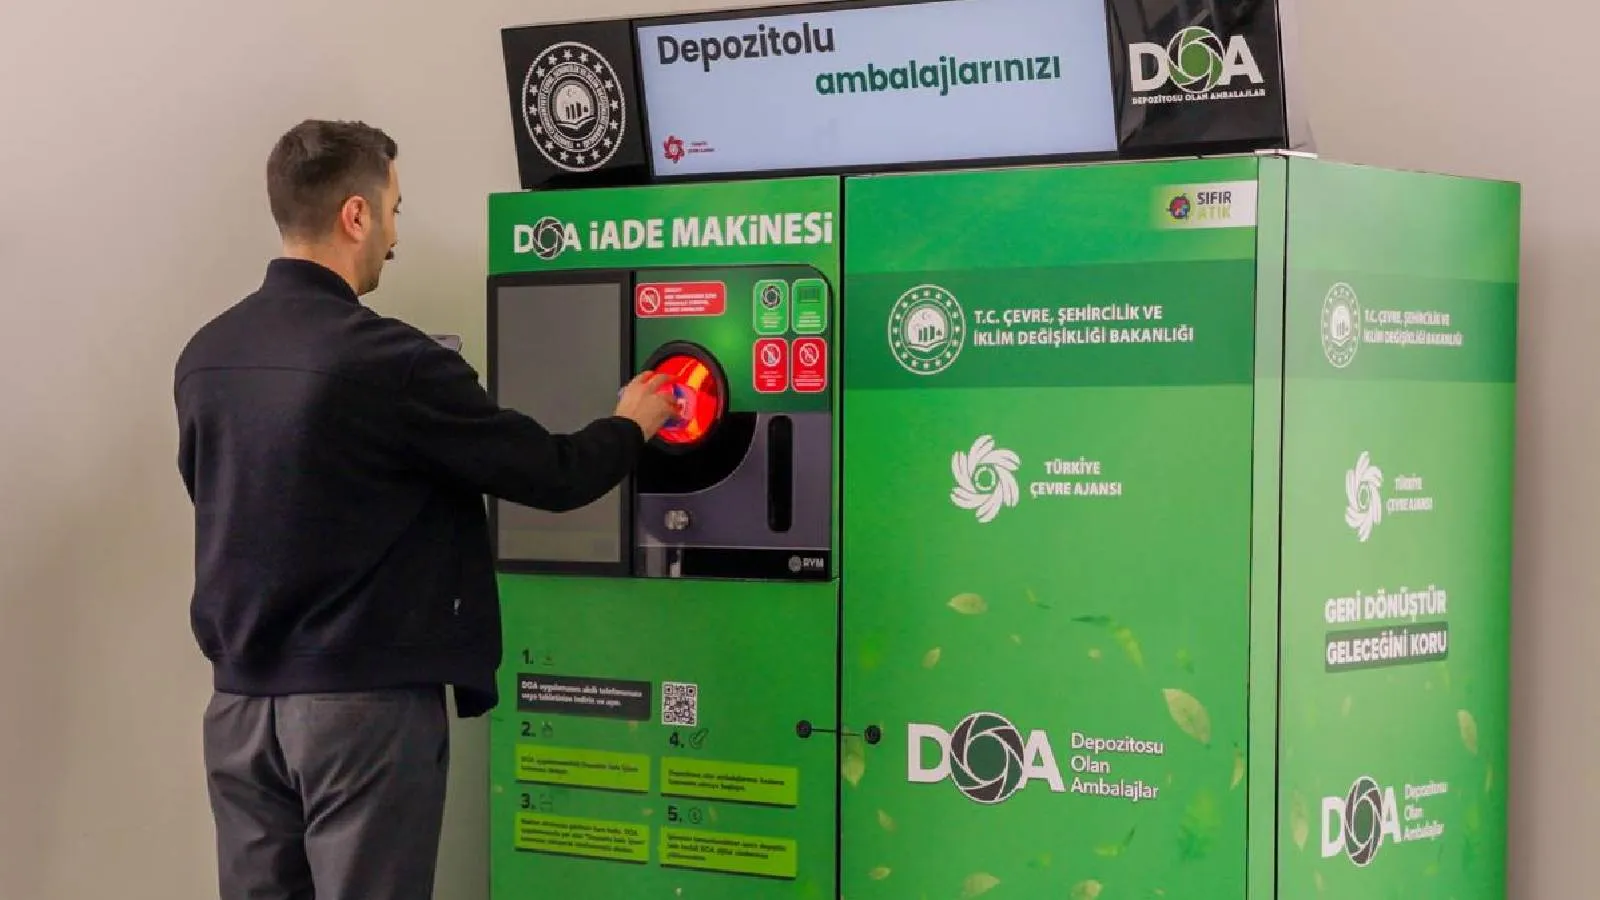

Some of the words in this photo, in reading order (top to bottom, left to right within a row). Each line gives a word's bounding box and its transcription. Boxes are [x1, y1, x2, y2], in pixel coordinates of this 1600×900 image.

[657, 22, 835, 72] Depozitolu
[1129, 26, 1263, 93] DOA
[815, 56, 1061, 96] ambalajlarınızı
[1197, 191, 1231, 205] SIFIR
[513, 216, 582, 260] DOA
[974, 310, 1000, 324] T.C.
[1003, 309, 1054, 327] ÇEVRE,
[1058, 303, 1139, 326] ŞEHİRCİLİK
[1142, 306, 1163, 320] VE
[974, 329, 1014, 346] İKLİM
[1018, 326, 1105, 348] DEĞİŞİKLİĞİ
[1110, 324, 1194, 343] BAKANLIĞI
[1044, 456, 1101, 475] TÜRKİYE
[1030, 482, 1071, 498] ÇEVRE
[1074, 482, 1122, 496] AJANSI
[1325, 590, 1361, 623] GERİ
[1364, 584, 1446, 623] DÖNÜŞTÜR
[1327, 628, 1407, 664] GELECEĞİNİ
[1411, 630, 1447, 656] KORU
[907, 711, 1066, 804] DOA
[1071, 732, 1163, 754] Depozitosu
[1071, 756, 1110, 773] Olan
[1071, 777, 1159, 802] Ambalajlar
[1321, 776, 1402, 867] DOA
